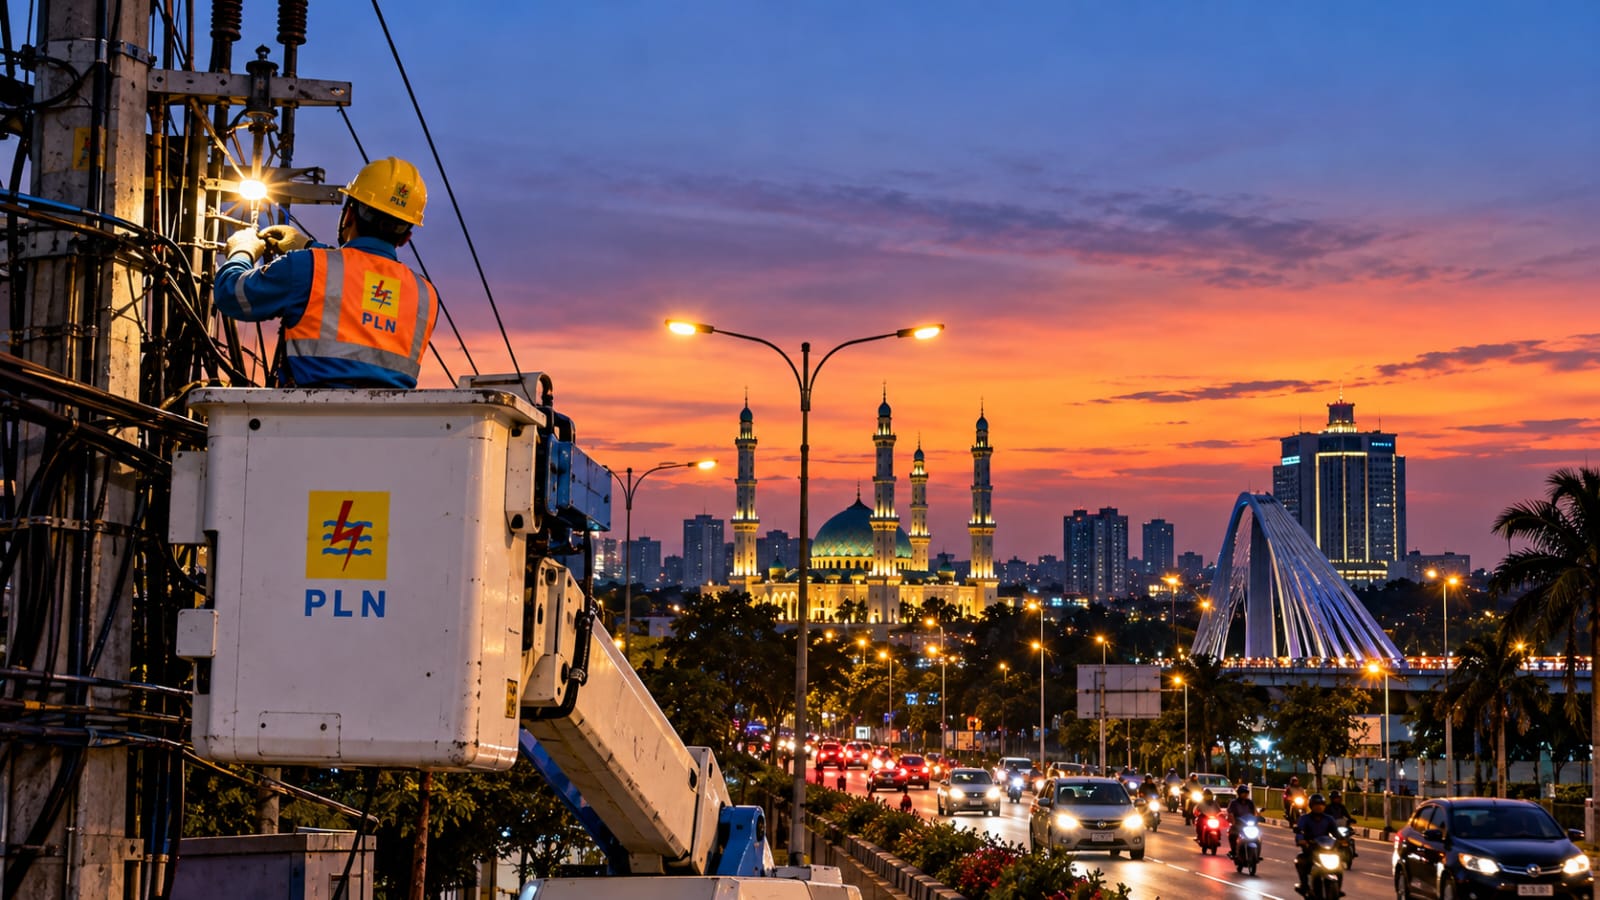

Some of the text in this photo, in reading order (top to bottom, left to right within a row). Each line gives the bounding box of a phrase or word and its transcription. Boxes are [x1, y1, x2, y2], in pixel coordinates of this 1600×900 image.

[390, 195, 407, 208] PLN
[362, 311, 396, 333] PLN
[304, 589, 386, 618] PLN
